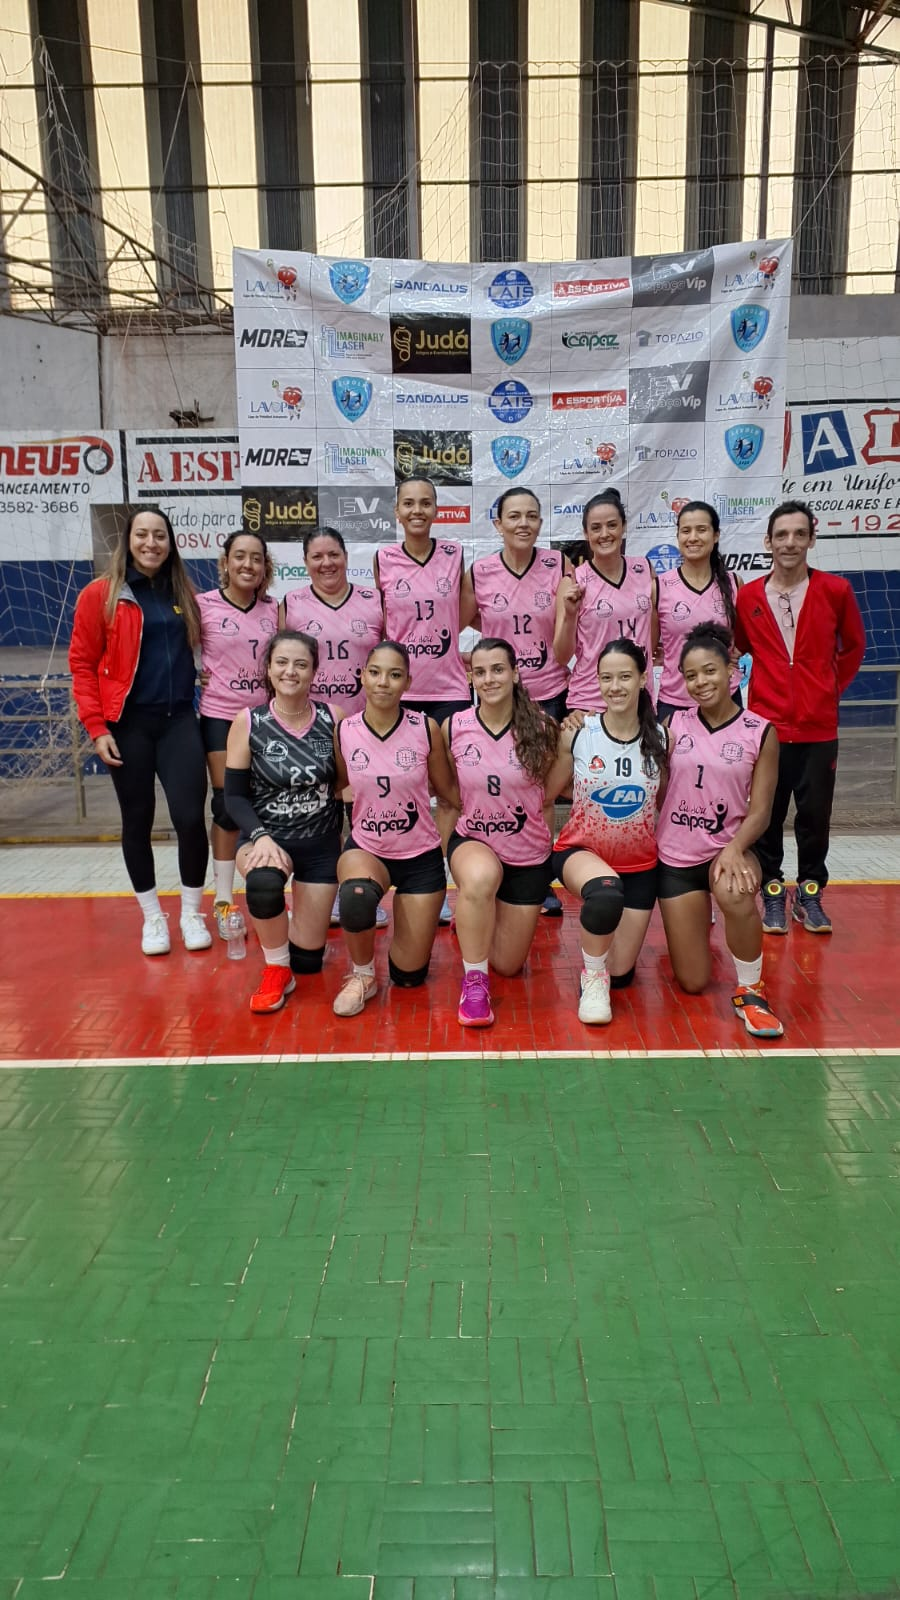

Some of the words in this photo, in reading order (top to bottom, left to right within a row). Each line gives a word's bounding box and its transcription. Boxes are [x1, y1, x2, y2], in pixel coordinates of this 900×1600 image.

[394, 279, 469, 293] SANDALUS
[488, 286, 534, 298] LAIS
[337, 341, 364, 351] LASER
[416, 328, 469, 350] Judá
[656, 331, 704, 344] TOPAZIO
[396, 394, 469, 404] SANDALUS
[488, 396, 533, 408] LAIS
[567, 394, 623, 405] ESPORTIVA
[340, 447, 387, 457] IMAGINARY
[340, 456, 367, 466] LASER
[655, 448, 698, 458] TOPAZIO
[137, 452, 163, 483] A
[803, 479, 833, 493] em
[265, 500, 317, 520] Judá
[202, 511, 236, 531] para
[415, 600, 434, 621] 13
[513, 614, 533, 634] 12
[618, 618, 637, 639] 14
[248, 639, 259, 660] 7
[326, 639, 349, 661] 16
[290, 765, 317, 786] 25
[614, 757, 632, 777] 19
[695, 764, 704, 789] 1
[377, 776, 391, 798] 9
[487, 775, 501, 797] 8
[612, 789, 644, 803] FAI
